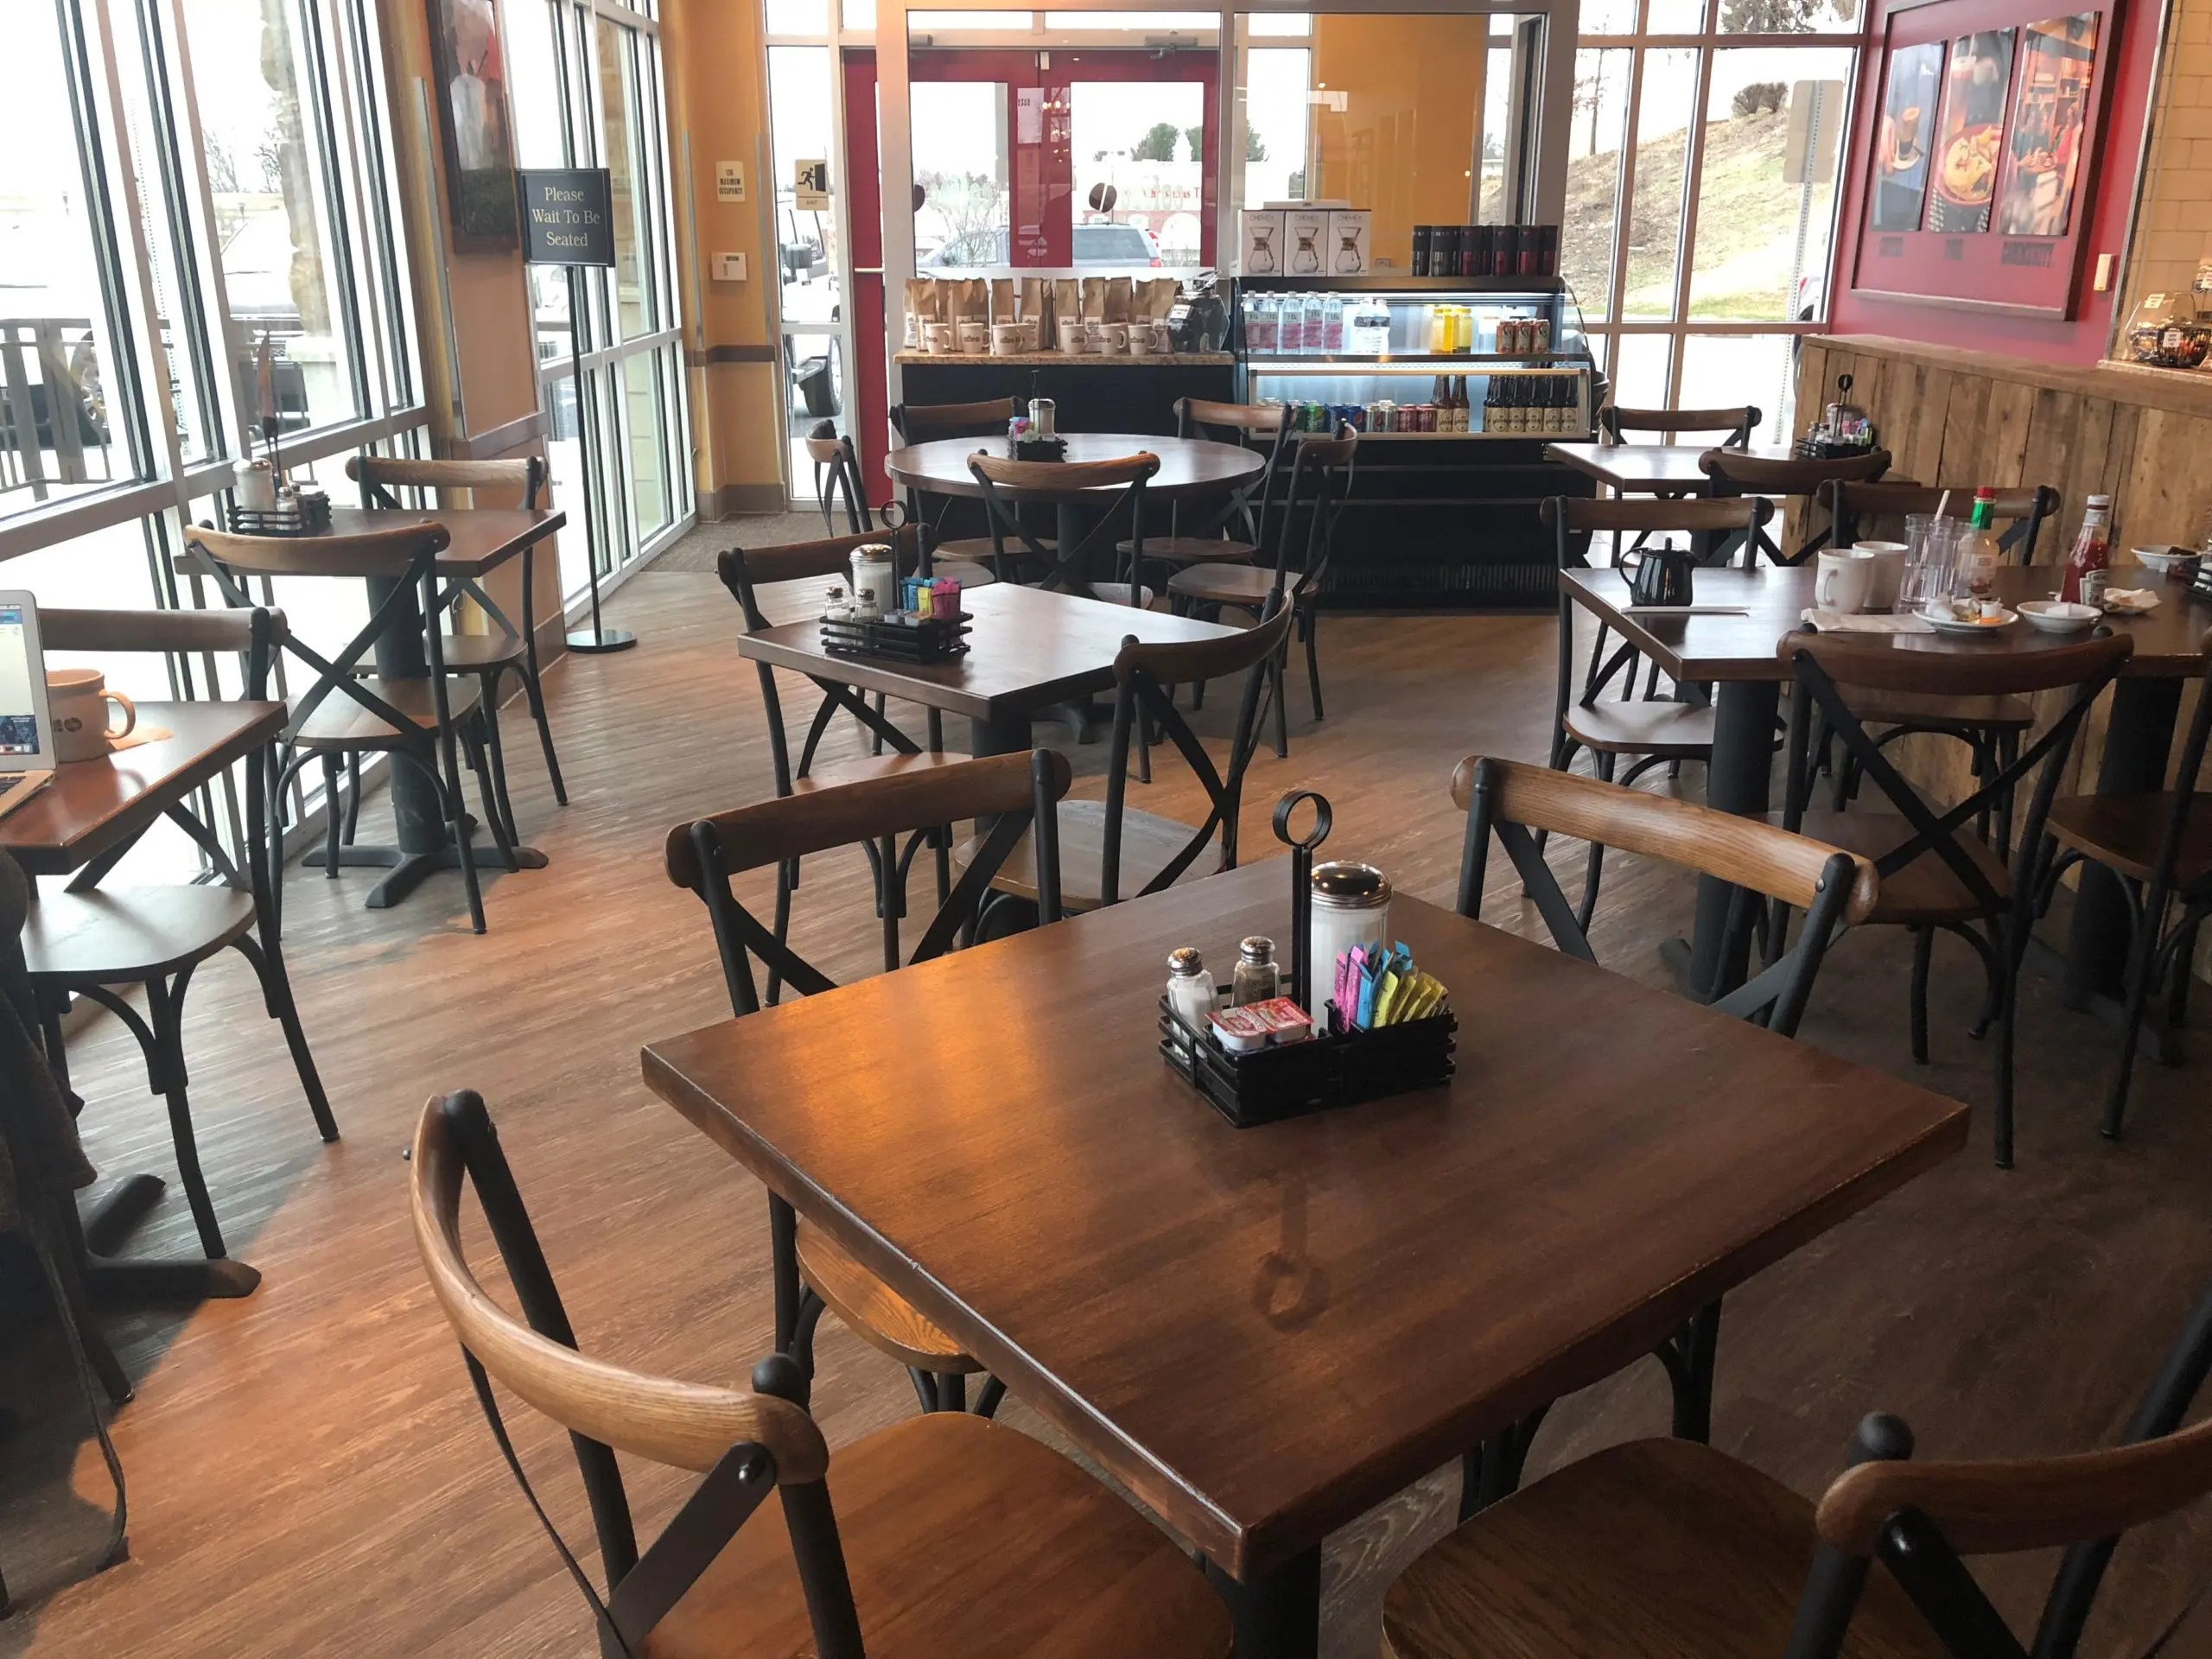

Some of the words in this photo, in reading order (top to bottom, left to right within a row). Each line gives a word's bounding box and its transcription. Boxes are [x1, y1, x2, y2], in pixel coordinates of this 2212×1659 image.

[544, 187, 584, 201] Please
[531, 208, 560, 224] Wait
[563, 209, 580, 224] To
[583, 210, 601, 225] Be
[545, 231, 588, 247] Seated
